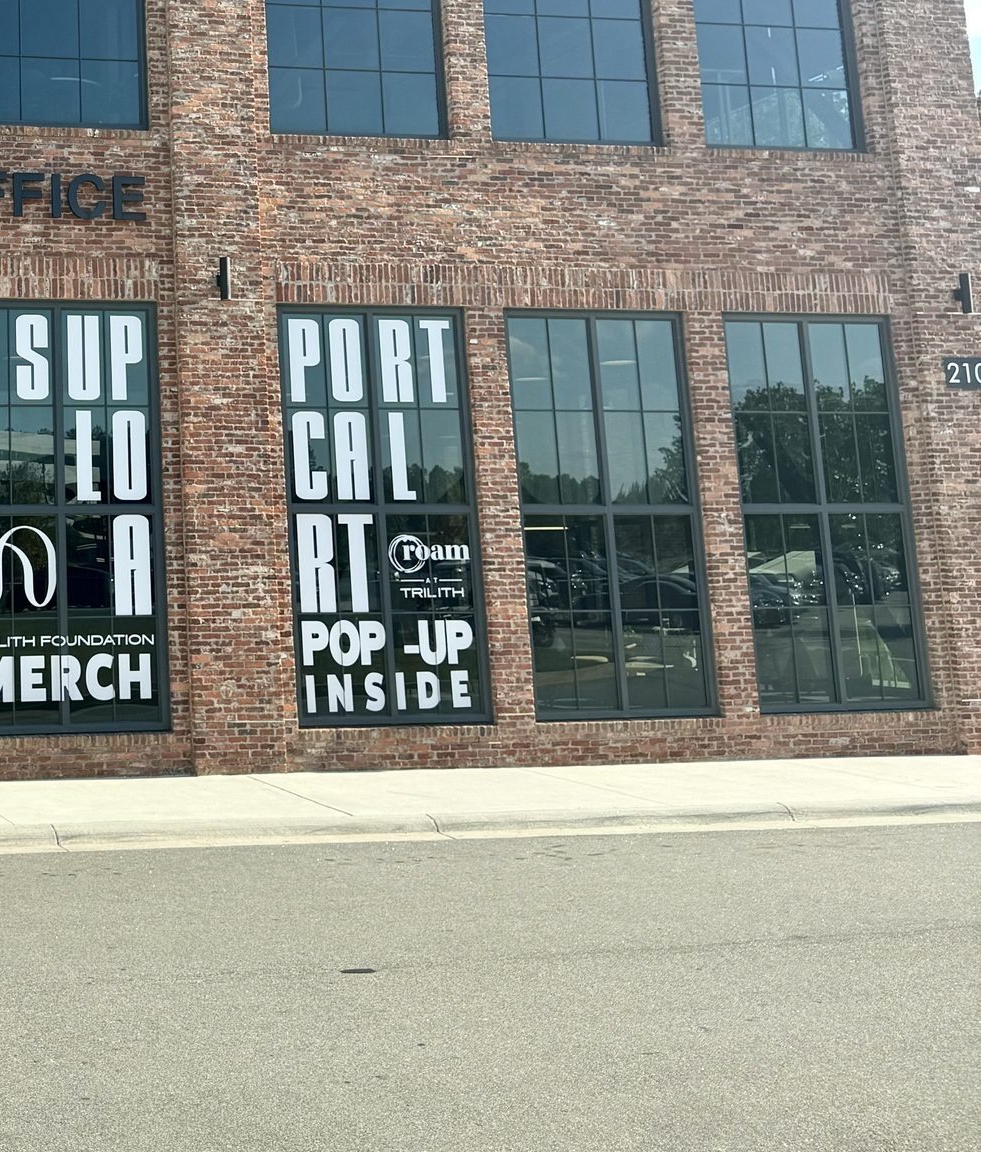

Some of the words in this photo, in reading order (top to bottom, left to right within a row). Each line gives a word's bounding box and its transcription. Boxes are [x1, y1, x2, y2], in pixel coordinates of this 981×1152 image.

[15, 314, 143, 401] SUP
[287, 318, 450, 404] PORT
[401, 544, 470, 561] roam
[399, 587, 465, 598] TRILITH
[40, 634, 155, 646] FOUNDATION
[306, 671, 472, 713] INSIDE
